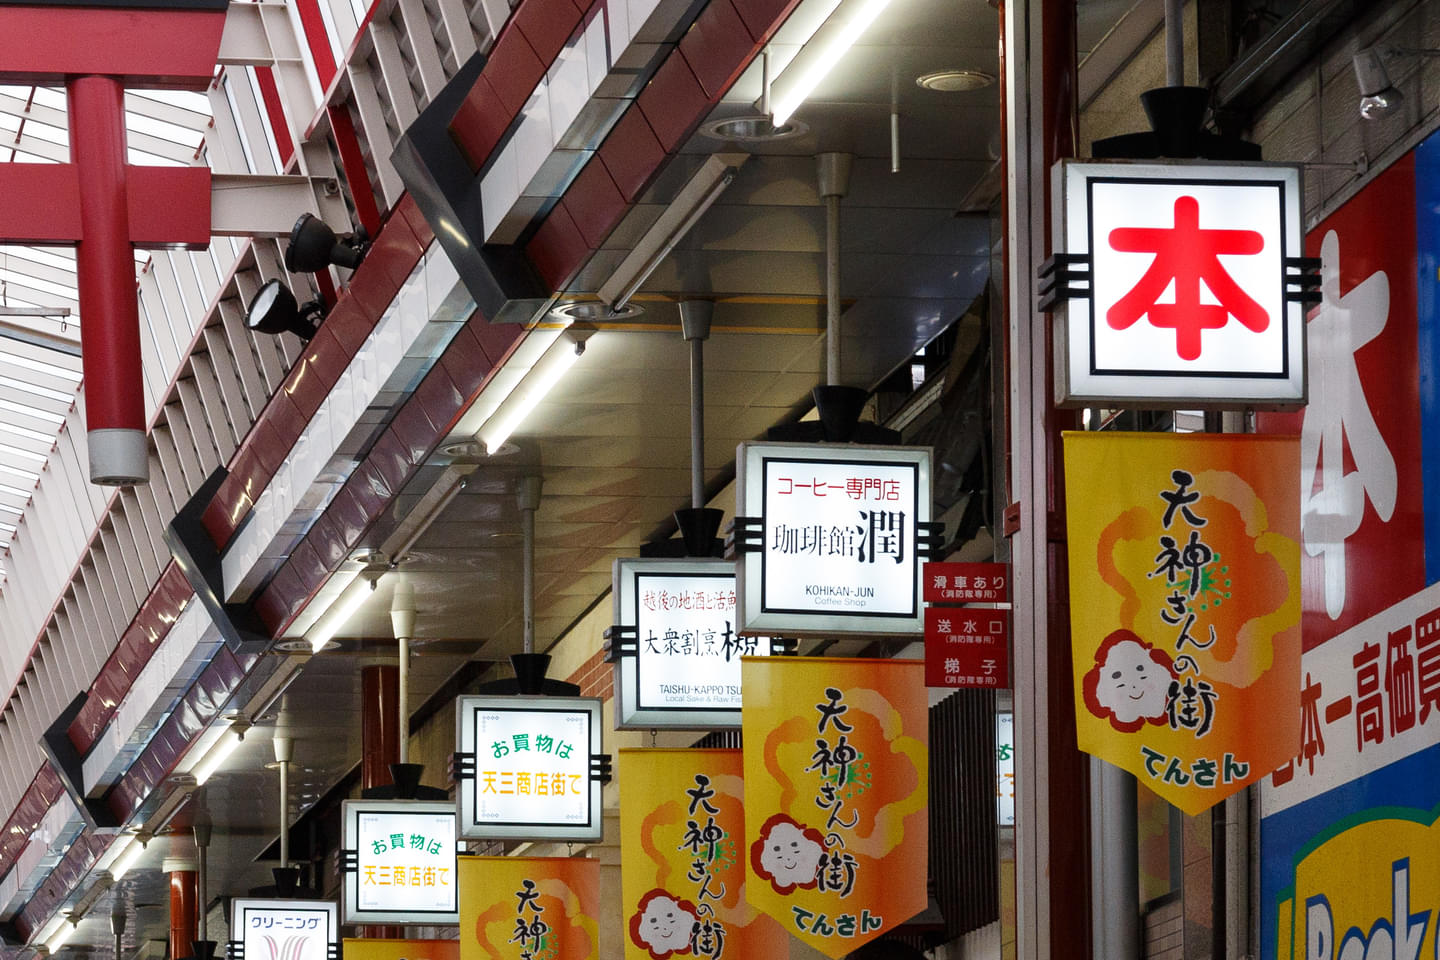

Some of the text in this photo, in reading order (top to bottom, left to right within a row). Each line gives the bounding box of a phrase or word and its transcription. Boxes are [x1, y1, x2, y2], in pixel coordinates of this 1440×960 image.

[1106, 195, 1271, 361] 本
[777, 477, 901, 502] コーヒー専門店
[771, 509, 906, 565] 珈琲館潤
[805, 585, 875, 599] KOHIKAN-JUN
[933, 575, 1005, 590] 滑車あり
[813, 597, 867, 608] Coffee Shop
[1149, 470, 1218, 739] 天神さんの街
[937, 619, 1003, 634] 送水口
[943, 657, 997, 675] 梯子
[659, 684, 724, 695] TAISHU-KAPPO
[490, 733, 574, 760] お買物は
[1140, 745, 1249, 787] てんさん
[804, 687, 860, 899] 天神さんの街
[371, 833, 443, 856] お買物は
[251, 916, 322, 930] クリーニング
[791, 905, 883, 937] てんさん
